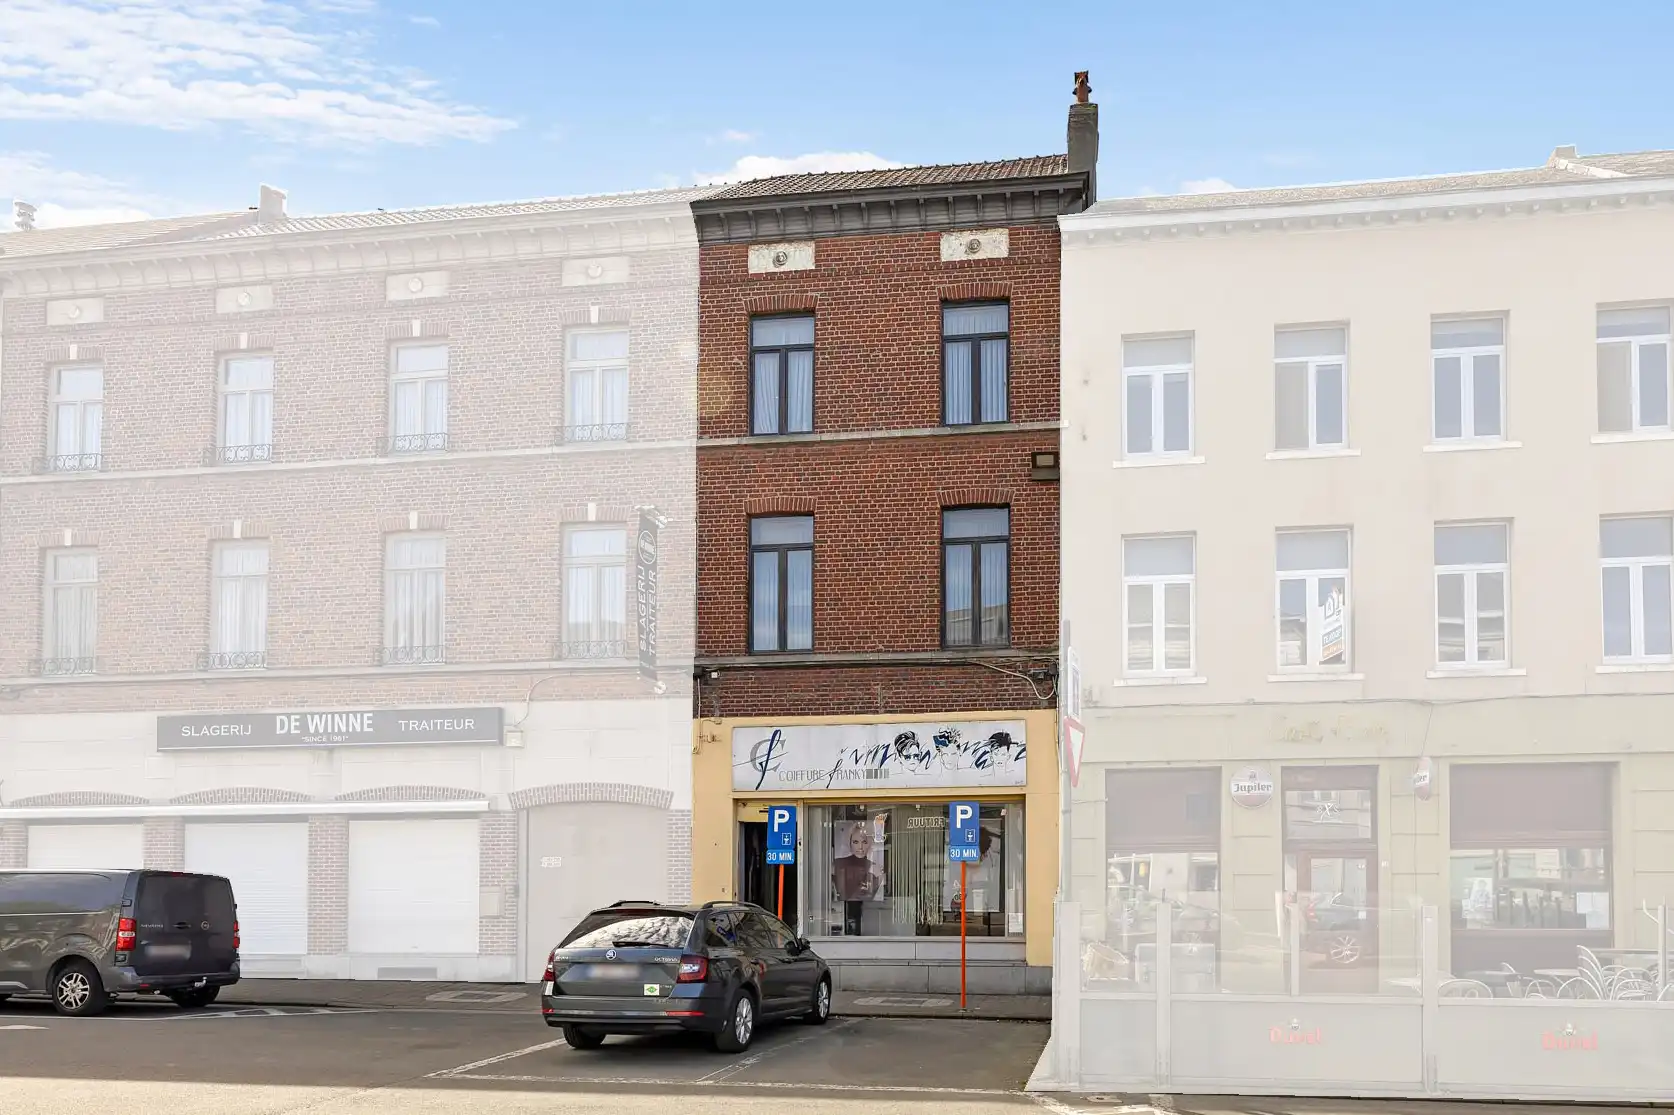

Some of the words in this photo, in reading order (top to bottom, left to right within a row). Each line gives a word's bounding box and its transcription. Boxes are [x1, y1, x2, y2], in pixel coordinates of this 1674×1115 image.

[637, 564, 647, 652] SLAGERIJ
[647, 570, 657, 657] TRAITEUR
[180, 723, 253, 738] SLAGERIJ
[275, 714, 301, 735] DE
[306, 712, 374, 734] WINNE
[398, 717, 476, 732] TRAITEUR
[778, 767, 826, 782] COIFFURE
[1233, 782, 1273, 794] Jupiler
[773, 808, 790, 833] P
[955, 804, 973, 829] P
[766, 851, 778, 863] 30
[950, 848, 961, 860] 30
[1268, 1025, 1322, 1046] Duvel
[1541, 1029, 1599, 1051] Duvel
